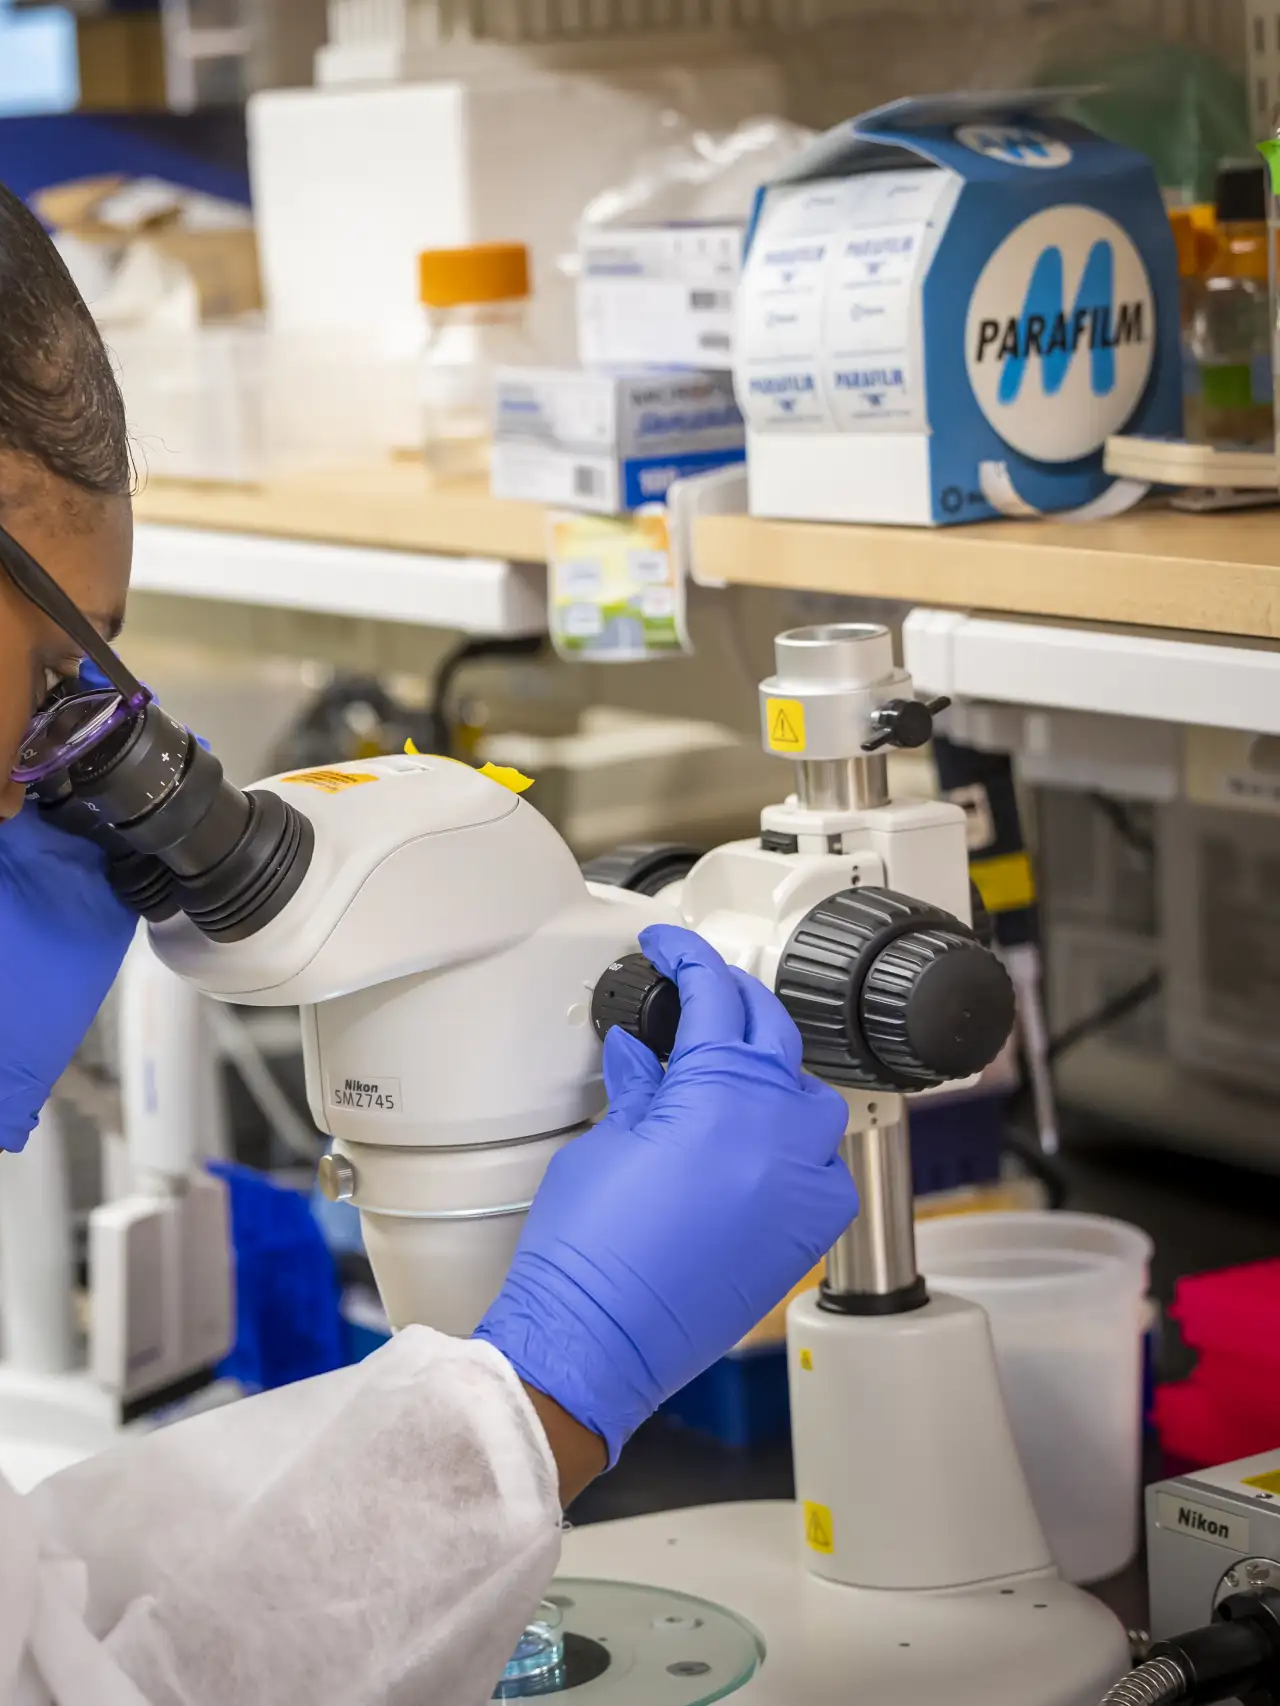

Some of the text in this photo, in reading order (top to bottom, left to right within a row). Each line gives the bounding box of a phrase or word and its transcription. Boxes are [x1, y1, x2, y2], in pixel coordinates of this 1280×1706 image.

[975, 299, 1143, 363] PARAFILM
[334, 1089, 395, 1110] SMZ745
[344, 1079, 379, 1094] Nikon
[1178, 1506, 1230, 1539] Nikon
